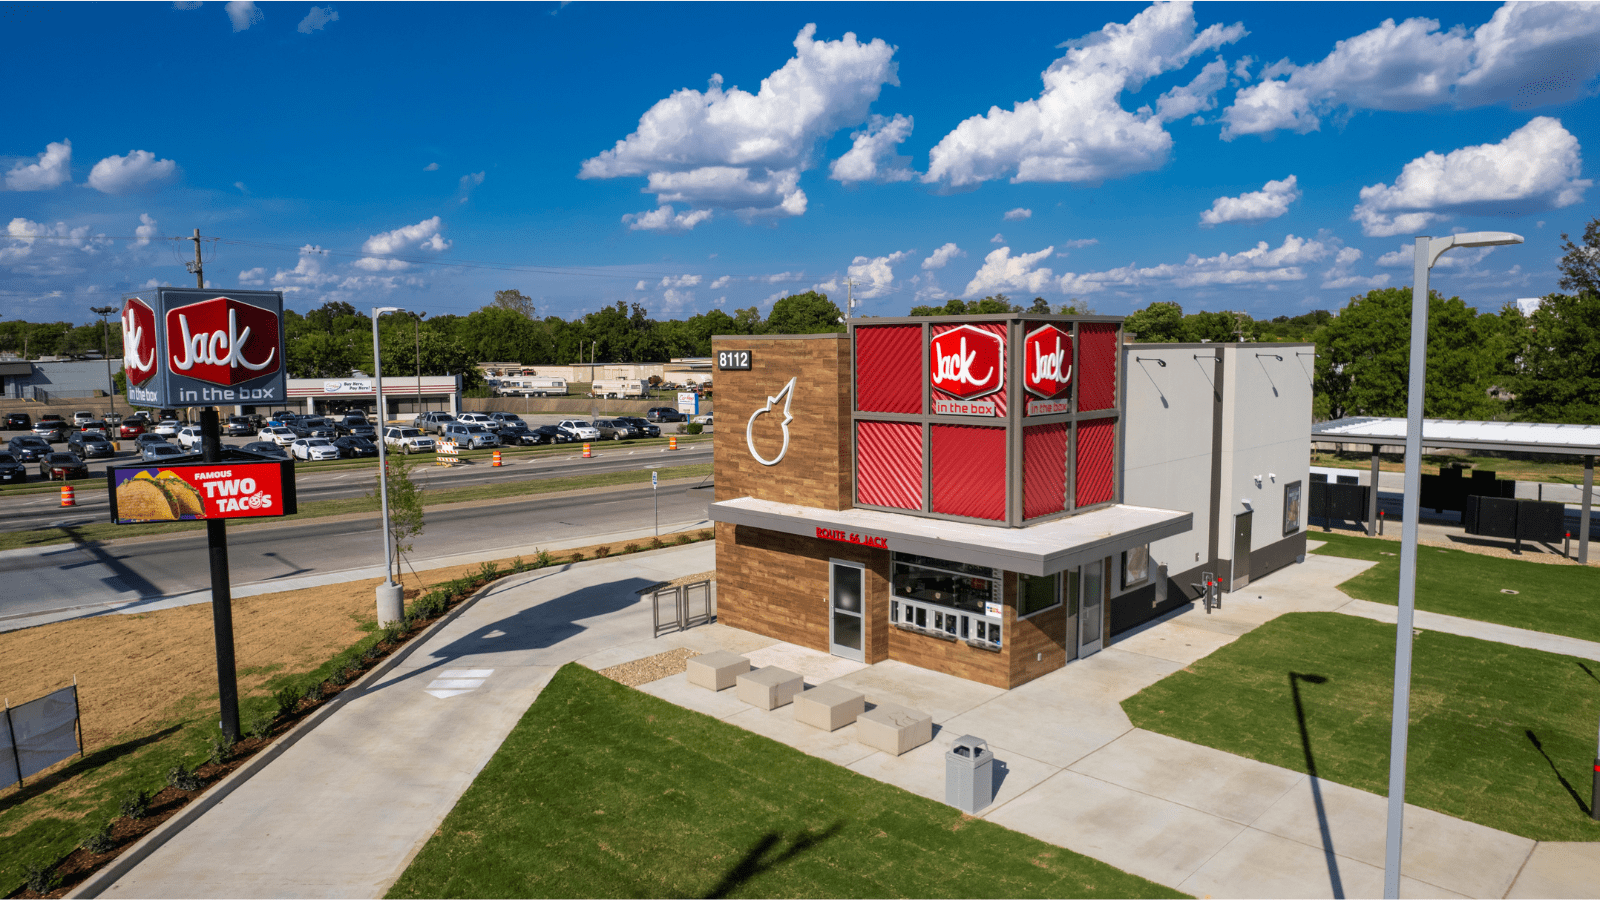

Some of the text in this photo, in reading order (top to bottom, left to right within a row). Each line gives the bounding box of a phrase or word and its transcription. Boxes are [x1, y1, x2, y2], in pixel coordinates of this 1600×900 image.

[173, 308, 275, 371] Jack
[720, 352, 748, 367] 8112
[932, 336, 994, 386] Jack
[1032, 336, 1072, 384] Jack
[129, 386, 158, 402] in the box
[180, 387, 275, 402] in the box
[937, 402, 993, 415] in the box
[1031, 402, 1067, 413] in the box
[194, 470, 232, 481] FAMOUS
[203, 478, 256, 498] TWO
[816, 527, 888, 549] ROUTE 66 JACK
